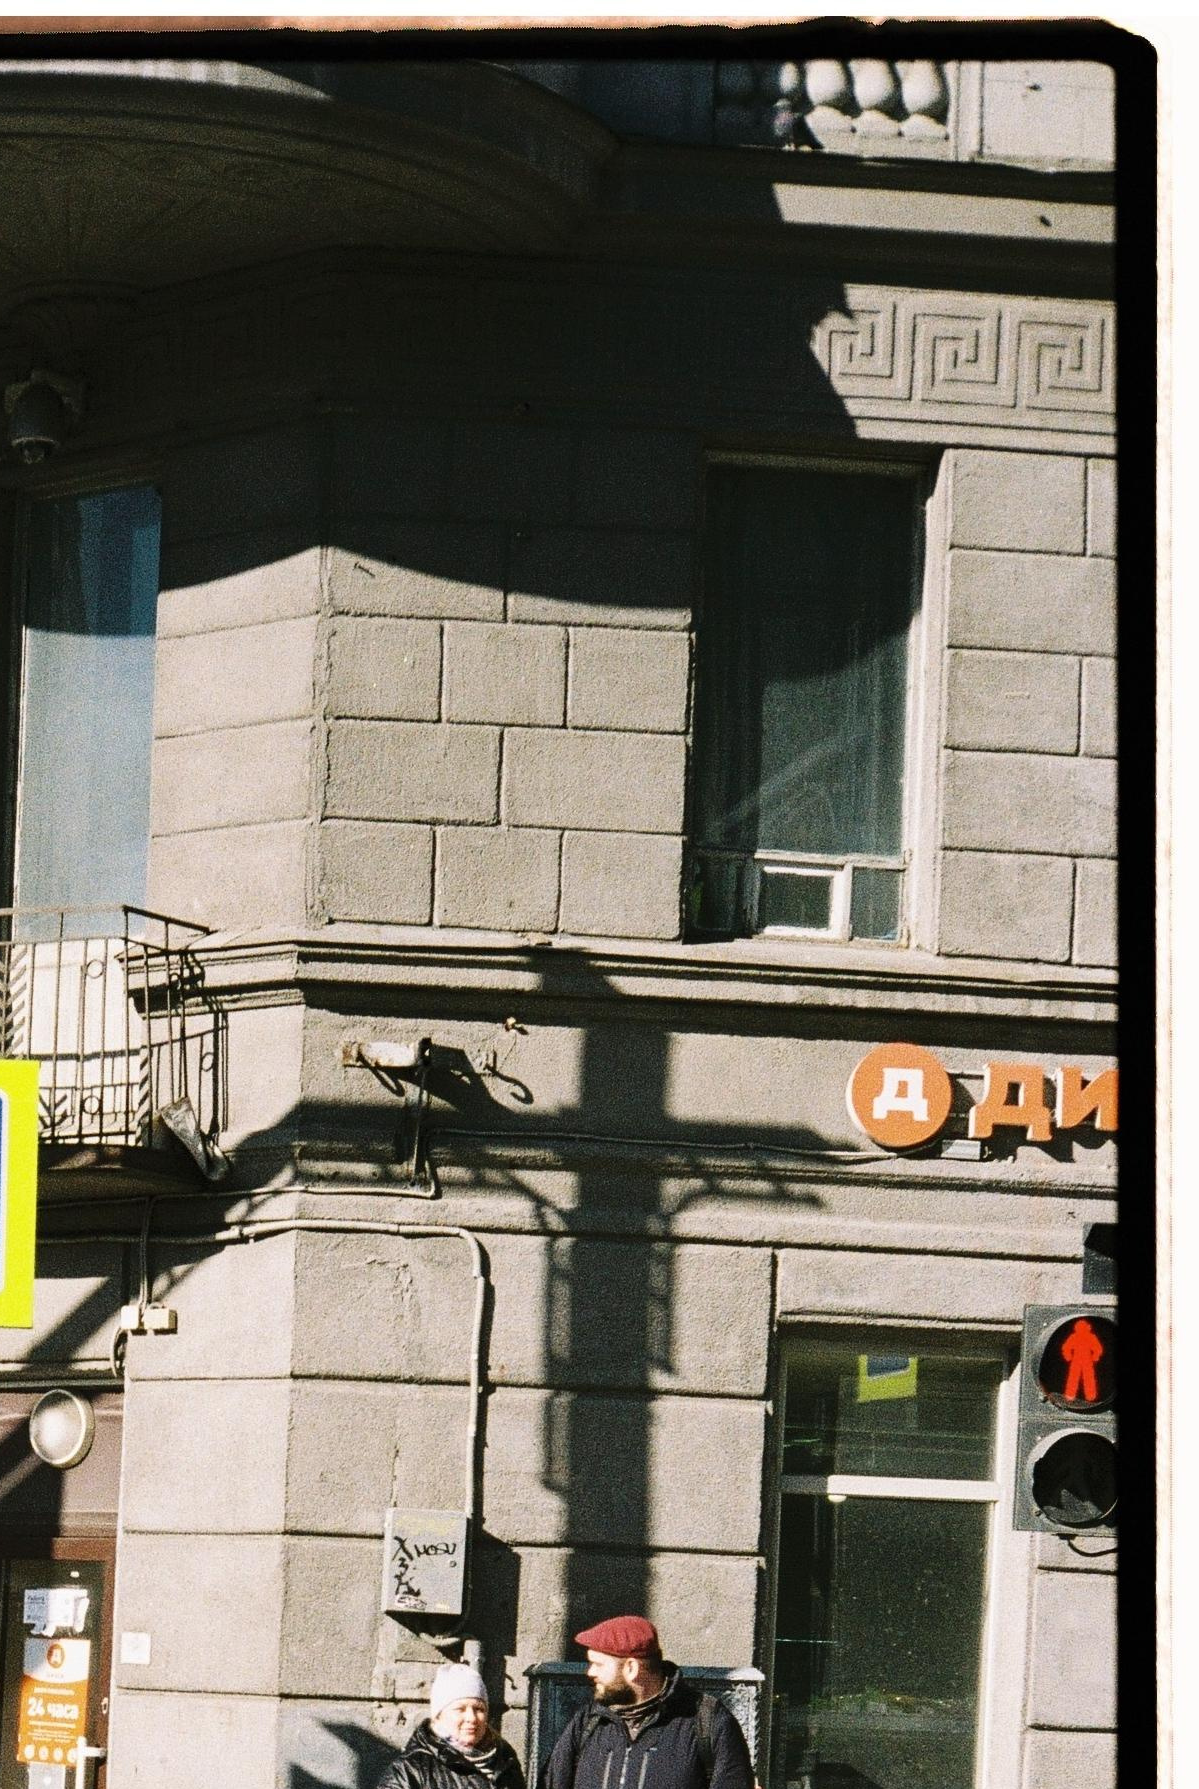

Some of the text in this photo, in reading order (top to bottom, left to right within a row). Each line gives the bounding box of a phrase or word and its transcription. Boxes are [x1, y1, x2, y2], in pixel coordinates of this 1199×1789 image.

[872, 1062, 1118, 1142] Д ДИ
[27, 1697, 80, 1720] 24 часа
